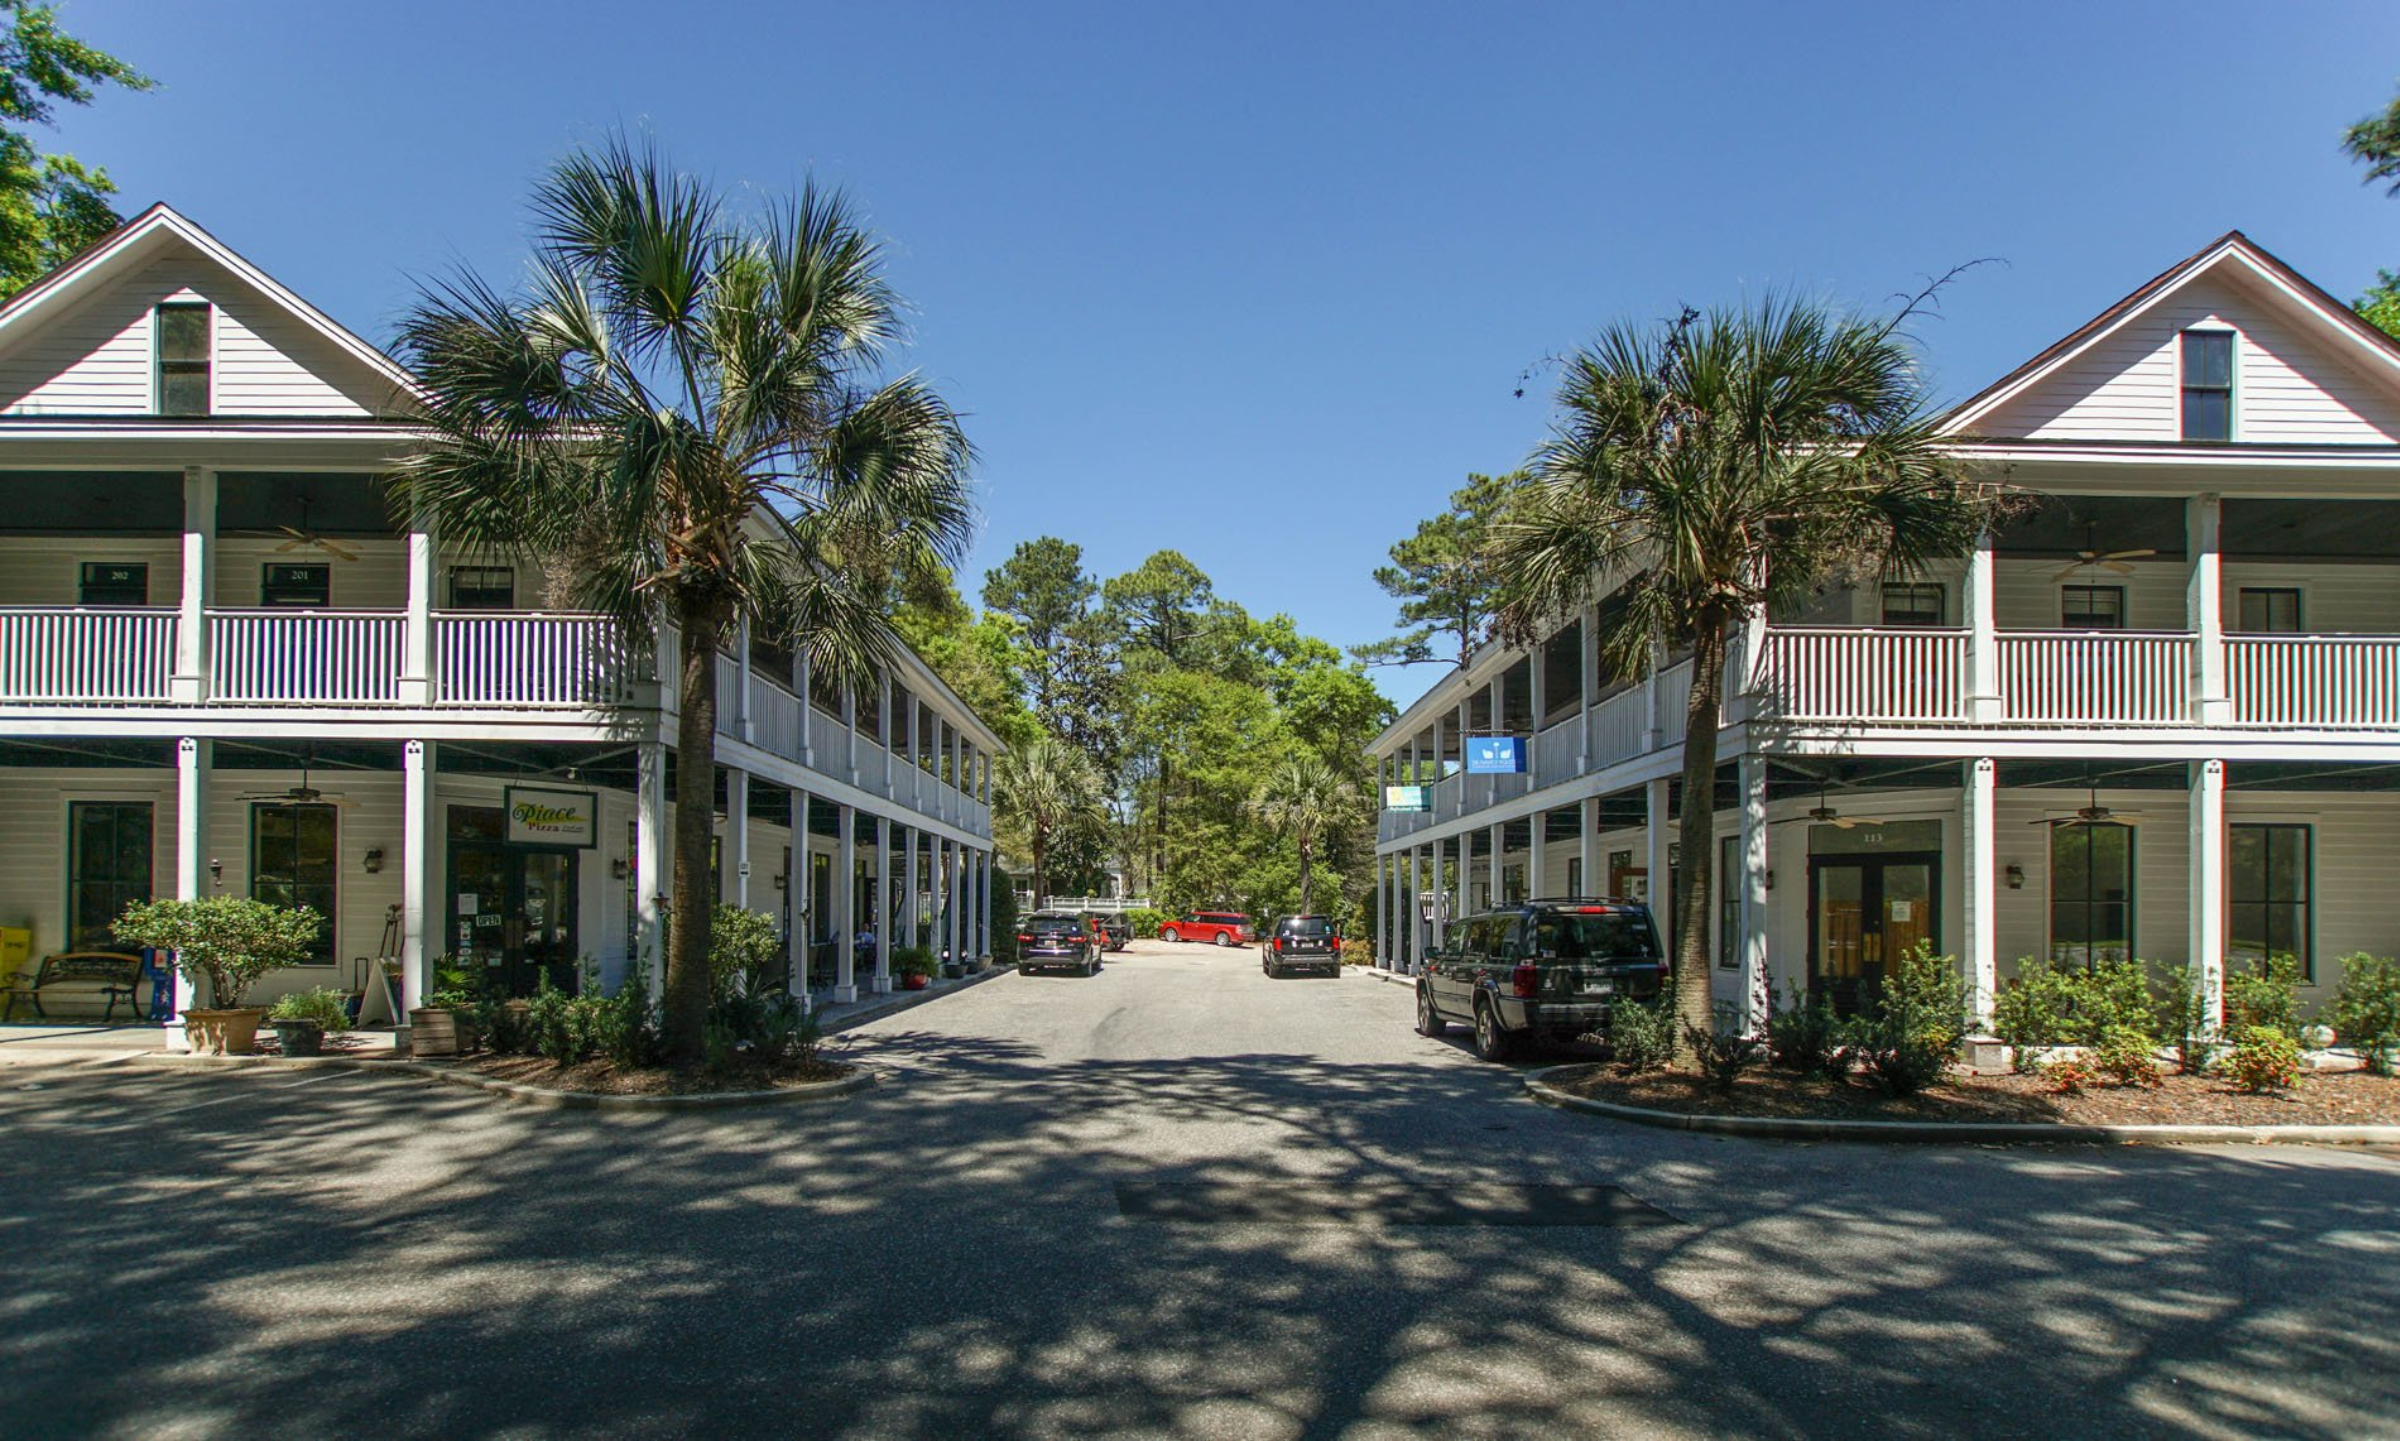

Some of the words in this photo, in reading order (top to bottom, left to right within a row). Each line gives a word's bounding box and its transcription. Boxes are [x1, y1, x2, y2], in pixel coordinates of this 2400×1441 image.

[292, 570, 308, 580] 201
[512, 804, 576, 822] Piace
[528, 822, 559, 832] Pizza
[479, 915, 499, 925] OPEN
